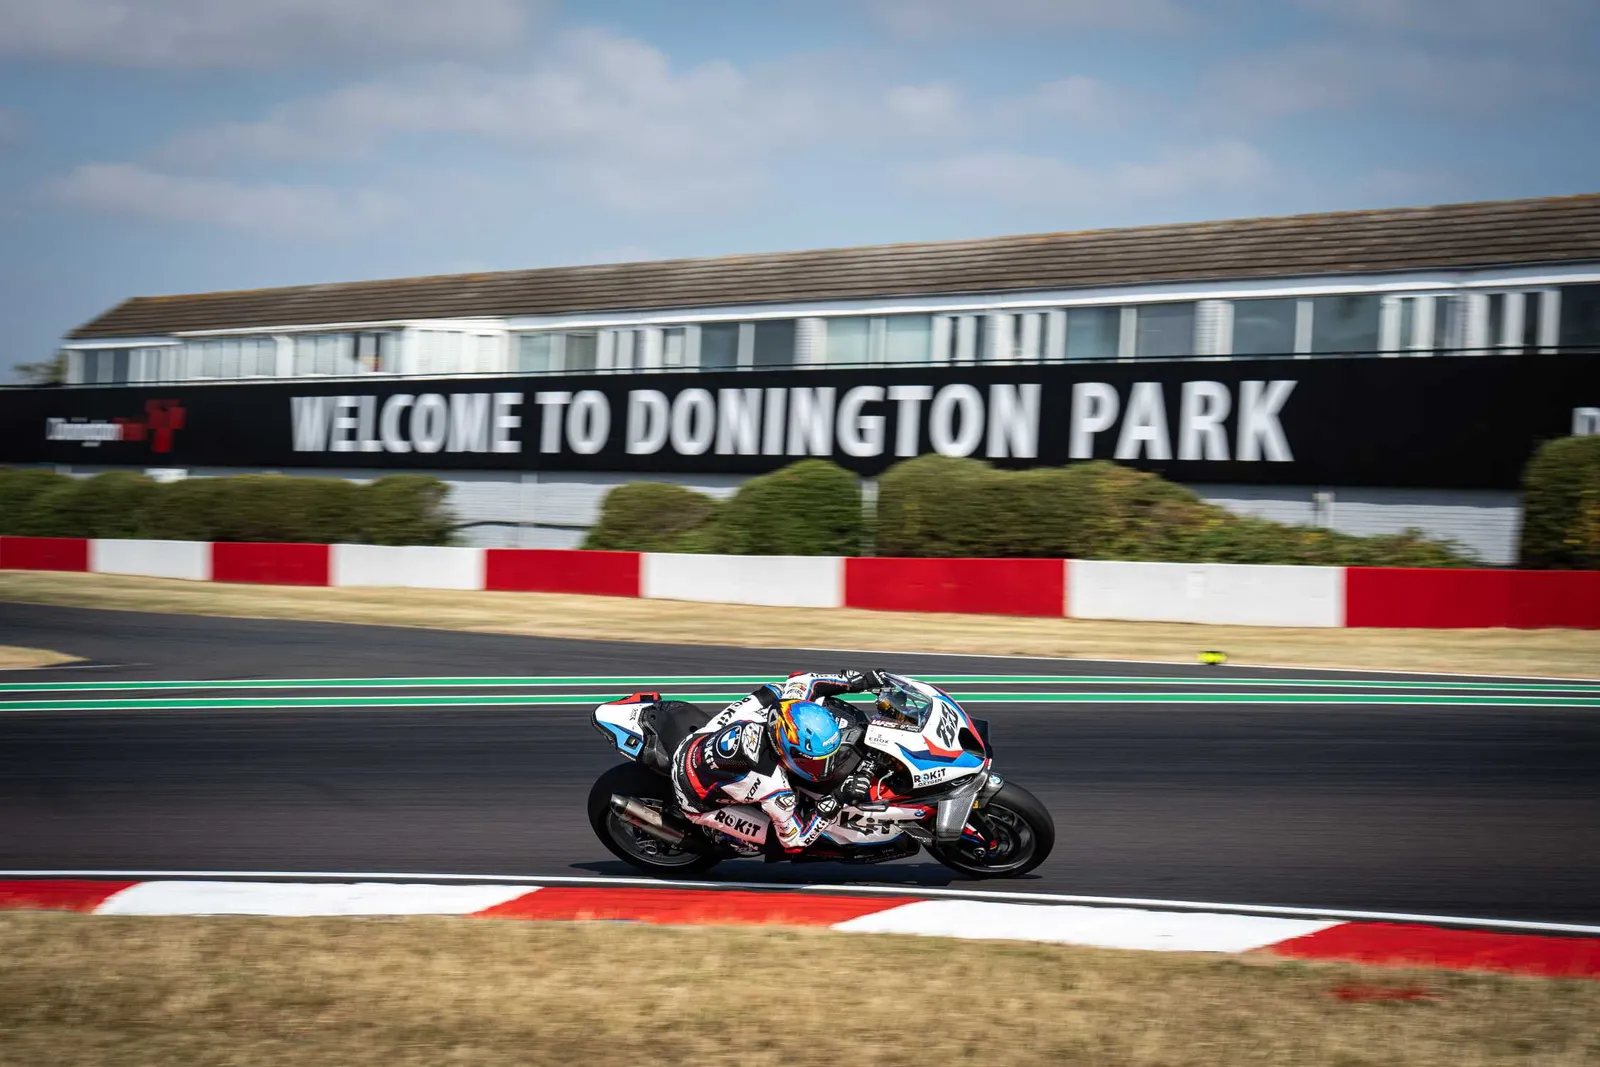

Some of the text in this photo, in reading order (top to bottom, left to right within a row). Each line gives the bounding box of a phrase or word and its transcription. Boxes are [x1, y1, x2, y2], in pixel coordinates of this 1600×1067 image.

[290, 380, 1298, 462] WELCOME TO DONINGTON PARK
